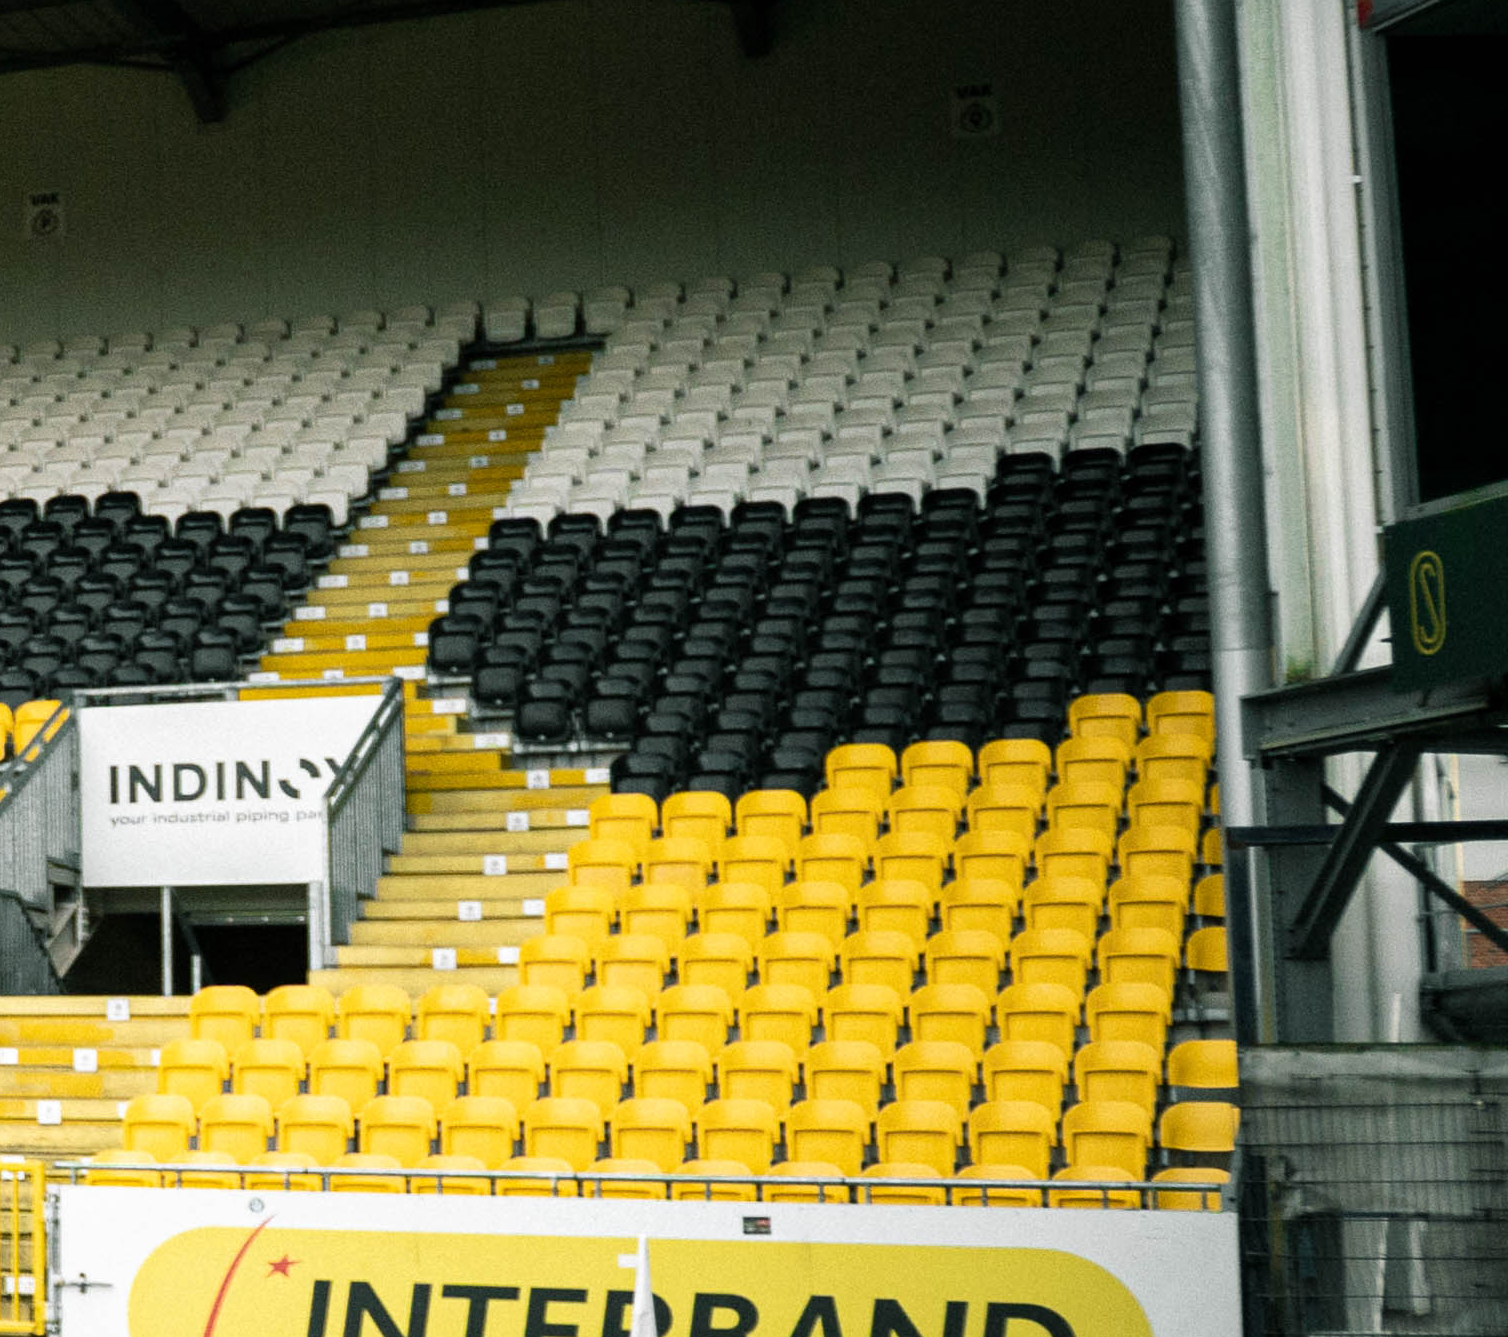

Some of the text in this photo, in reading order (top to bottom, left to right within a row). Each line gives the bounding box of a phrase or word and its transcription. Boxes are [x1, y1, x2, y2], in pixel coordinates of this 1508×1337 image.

[110, 809, 325, 826] your industrial piping par
